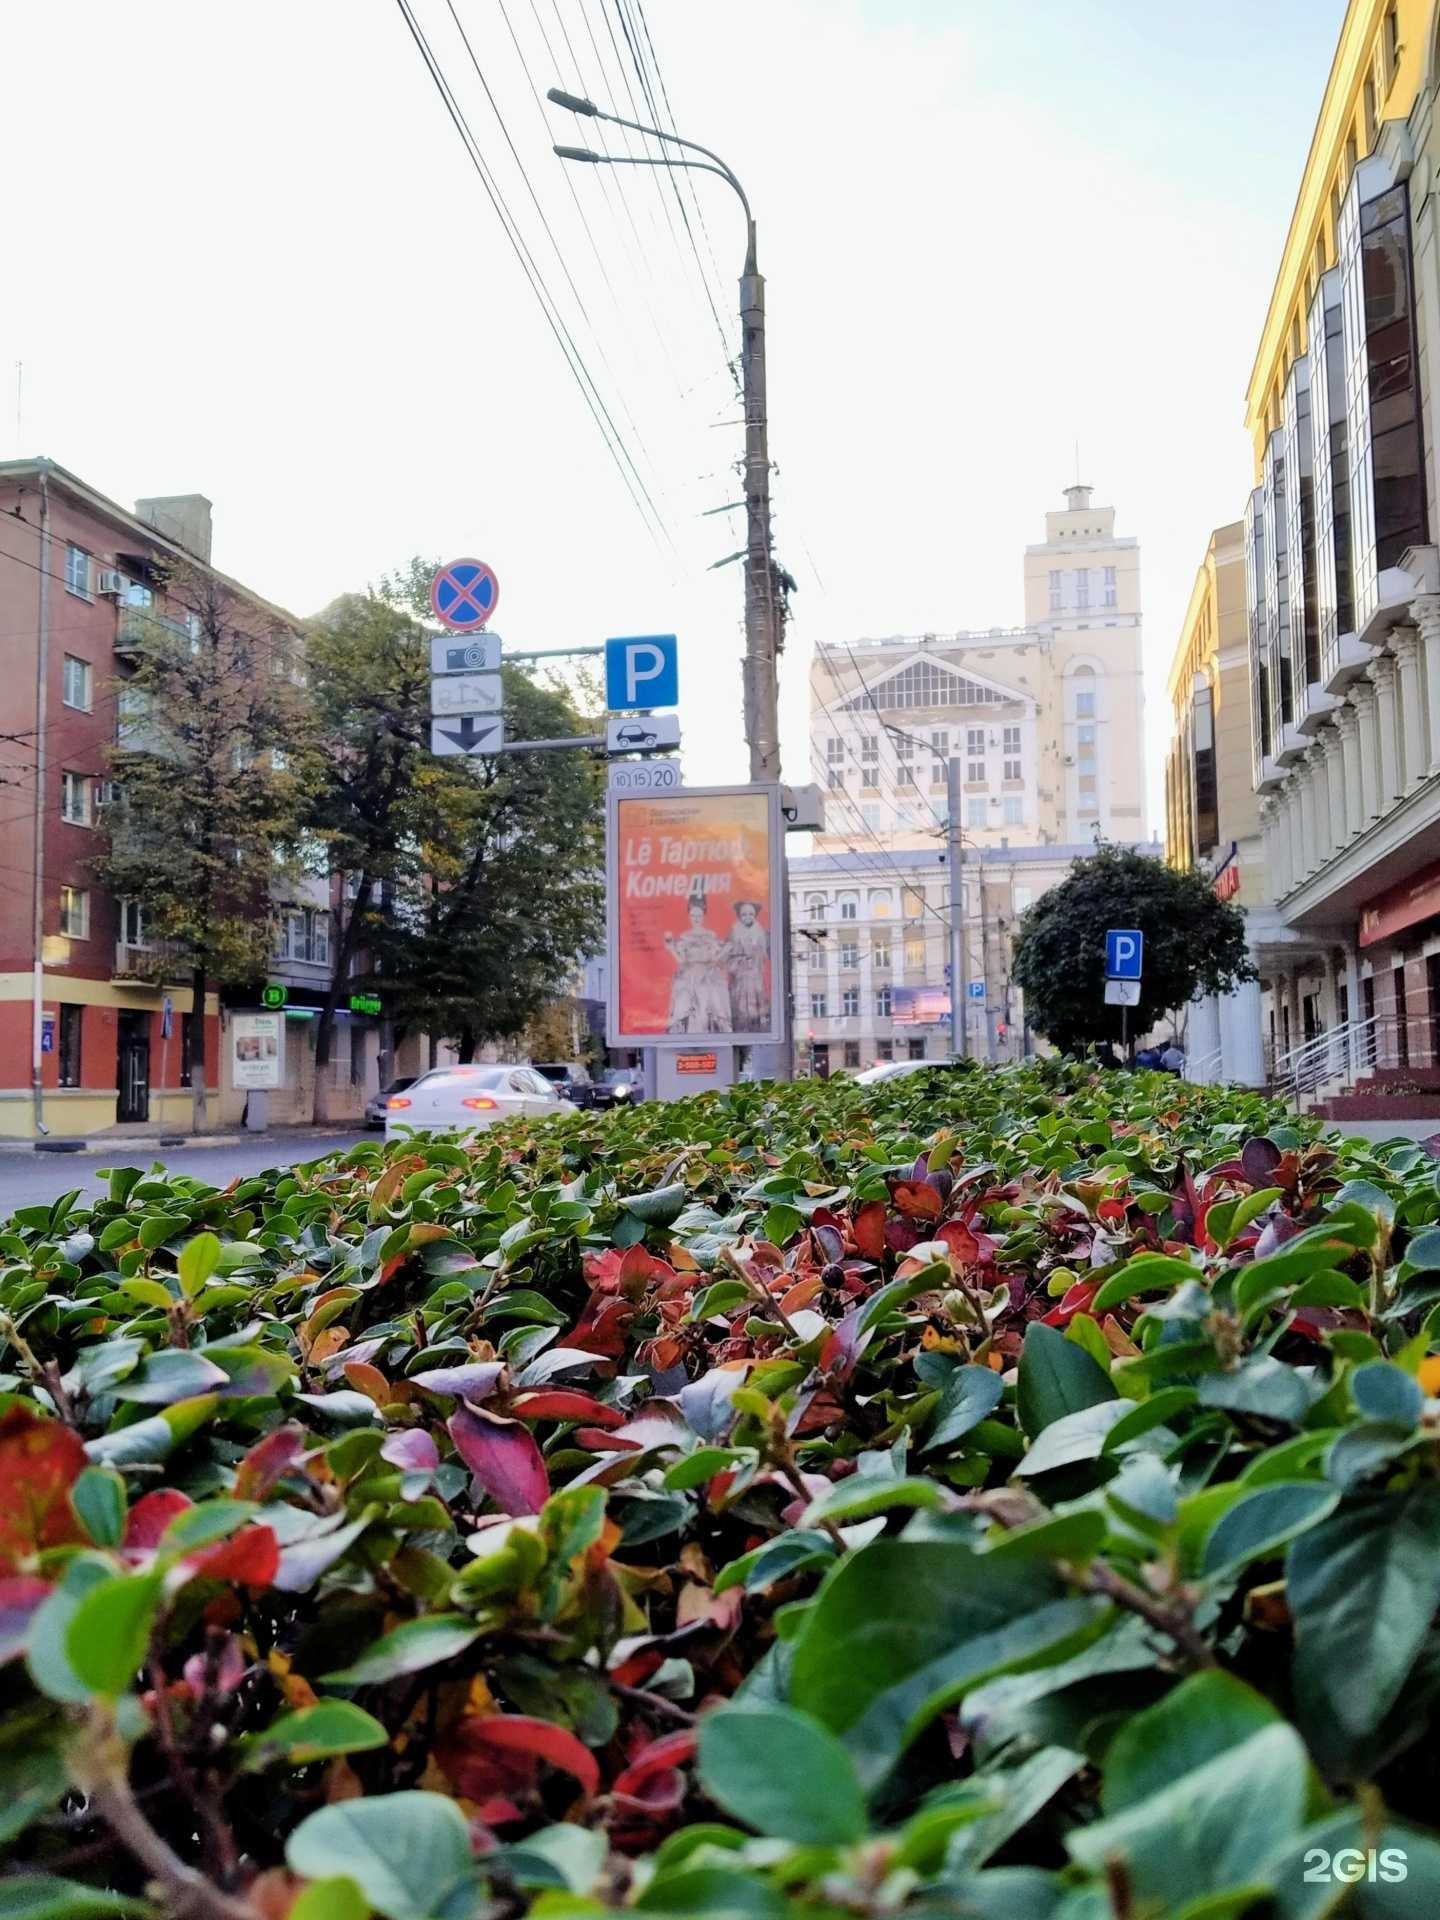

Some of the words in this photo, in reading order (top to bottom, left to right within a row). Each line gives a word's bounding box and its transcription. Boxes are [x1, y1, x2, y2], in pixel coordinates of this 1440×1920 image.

[625, 644, 665, 702] P
[616, 776, 626, 787] 10
[633, 773, 646, 786] 15
[654, 769, 672, 787] 20
[626, 871, 732, 899] Комедия
[1116, 936, 1135, 972] P
[973, 983, 982, 997] P
